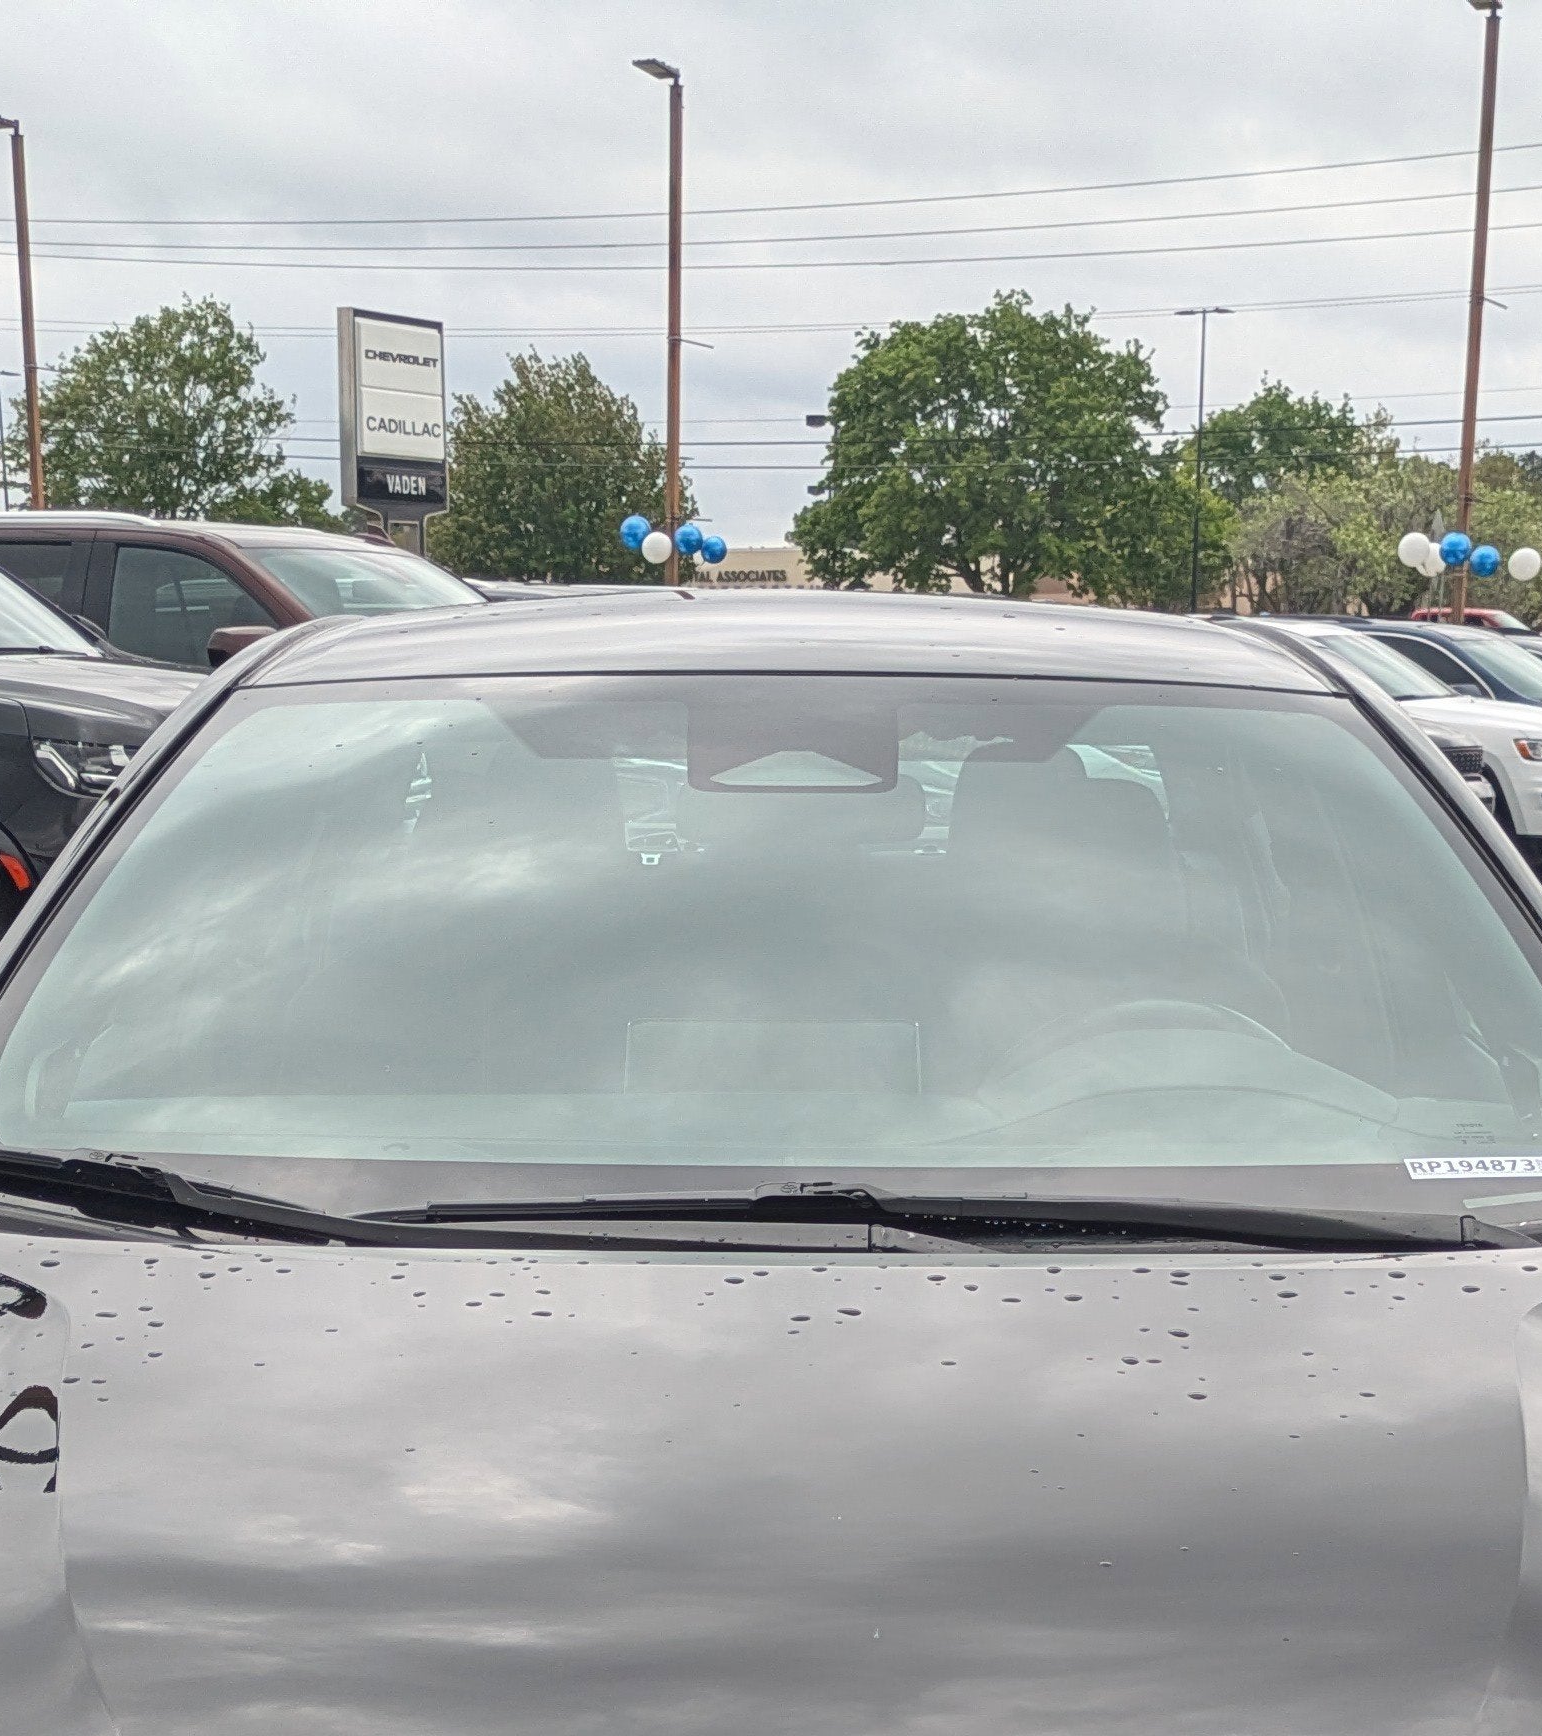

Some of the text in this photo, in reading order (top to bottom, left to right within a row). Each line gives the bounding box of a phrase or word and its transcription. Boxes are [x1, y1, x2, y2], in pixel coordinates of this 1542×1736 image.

[364, 349, 439, 369] CHEVROLET
[366, 416, 442, 439] CADILLAC
[386, 474, 427, 496] VADEN
[716, 570, 787, 583] ASSOCIATES
[1409, 1158, 1537, 1174] RP194873
